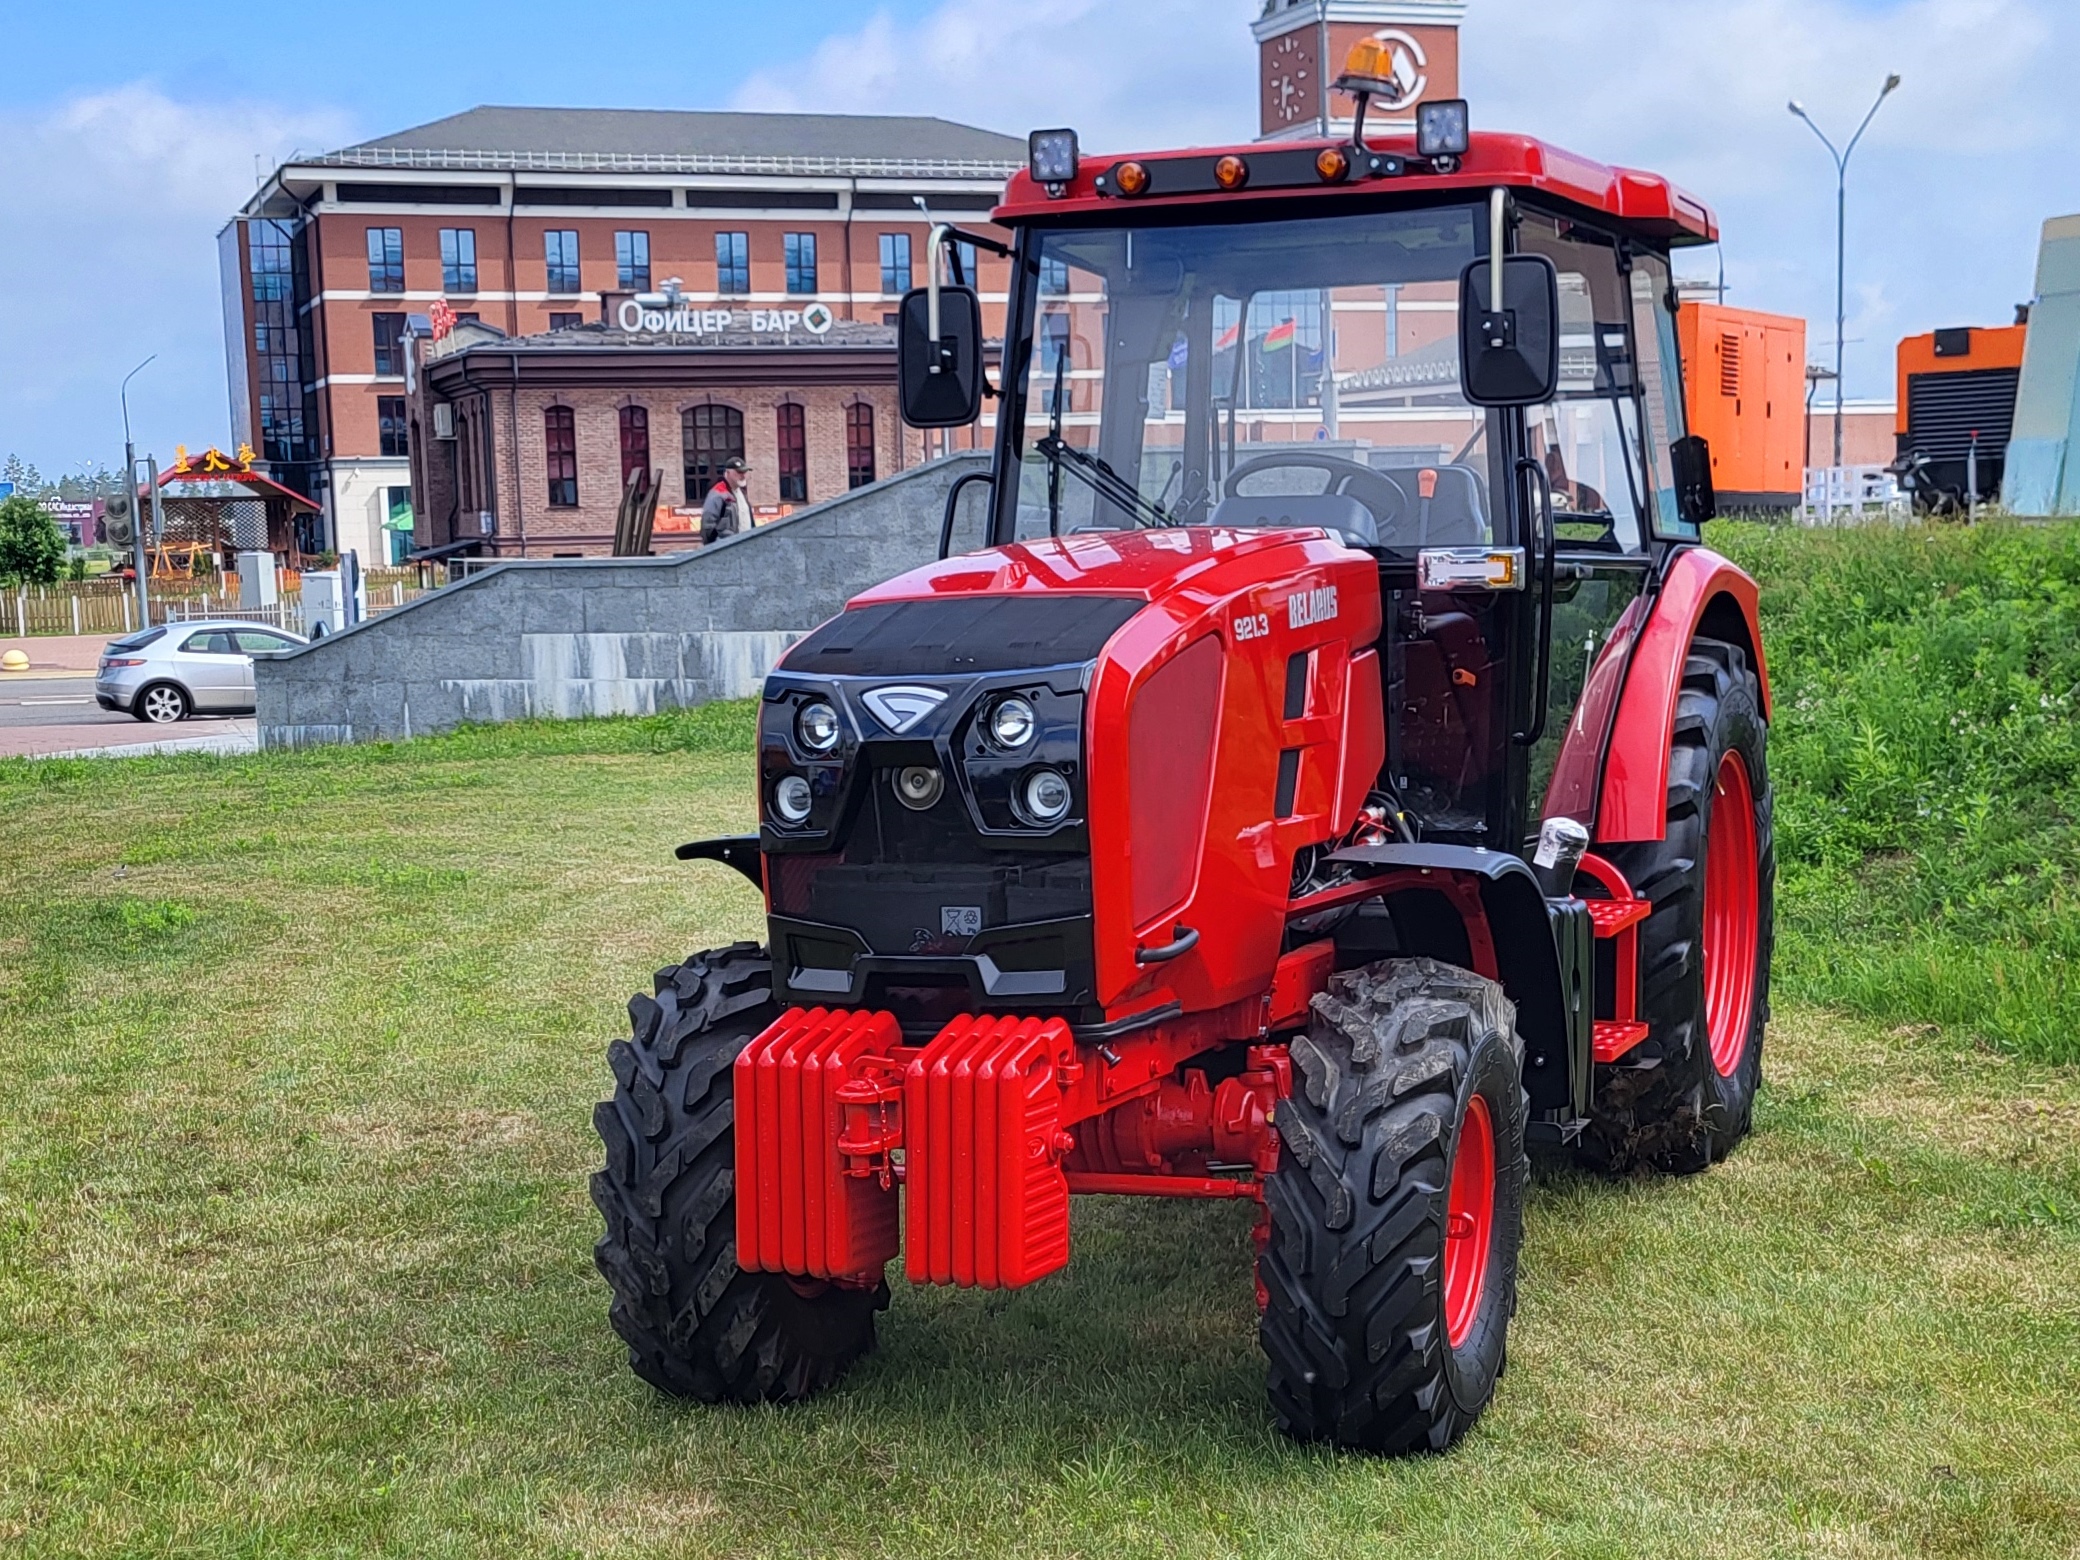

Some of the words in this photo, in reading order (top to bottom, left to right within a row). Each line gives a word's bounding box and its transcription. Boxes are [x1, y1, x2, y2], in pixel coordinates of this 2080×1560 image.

[751, 310, 800, 332] БАР
[1288, 585, 1338, 629] BELARUS
[1234, 613, 1269, 641] 921.3
